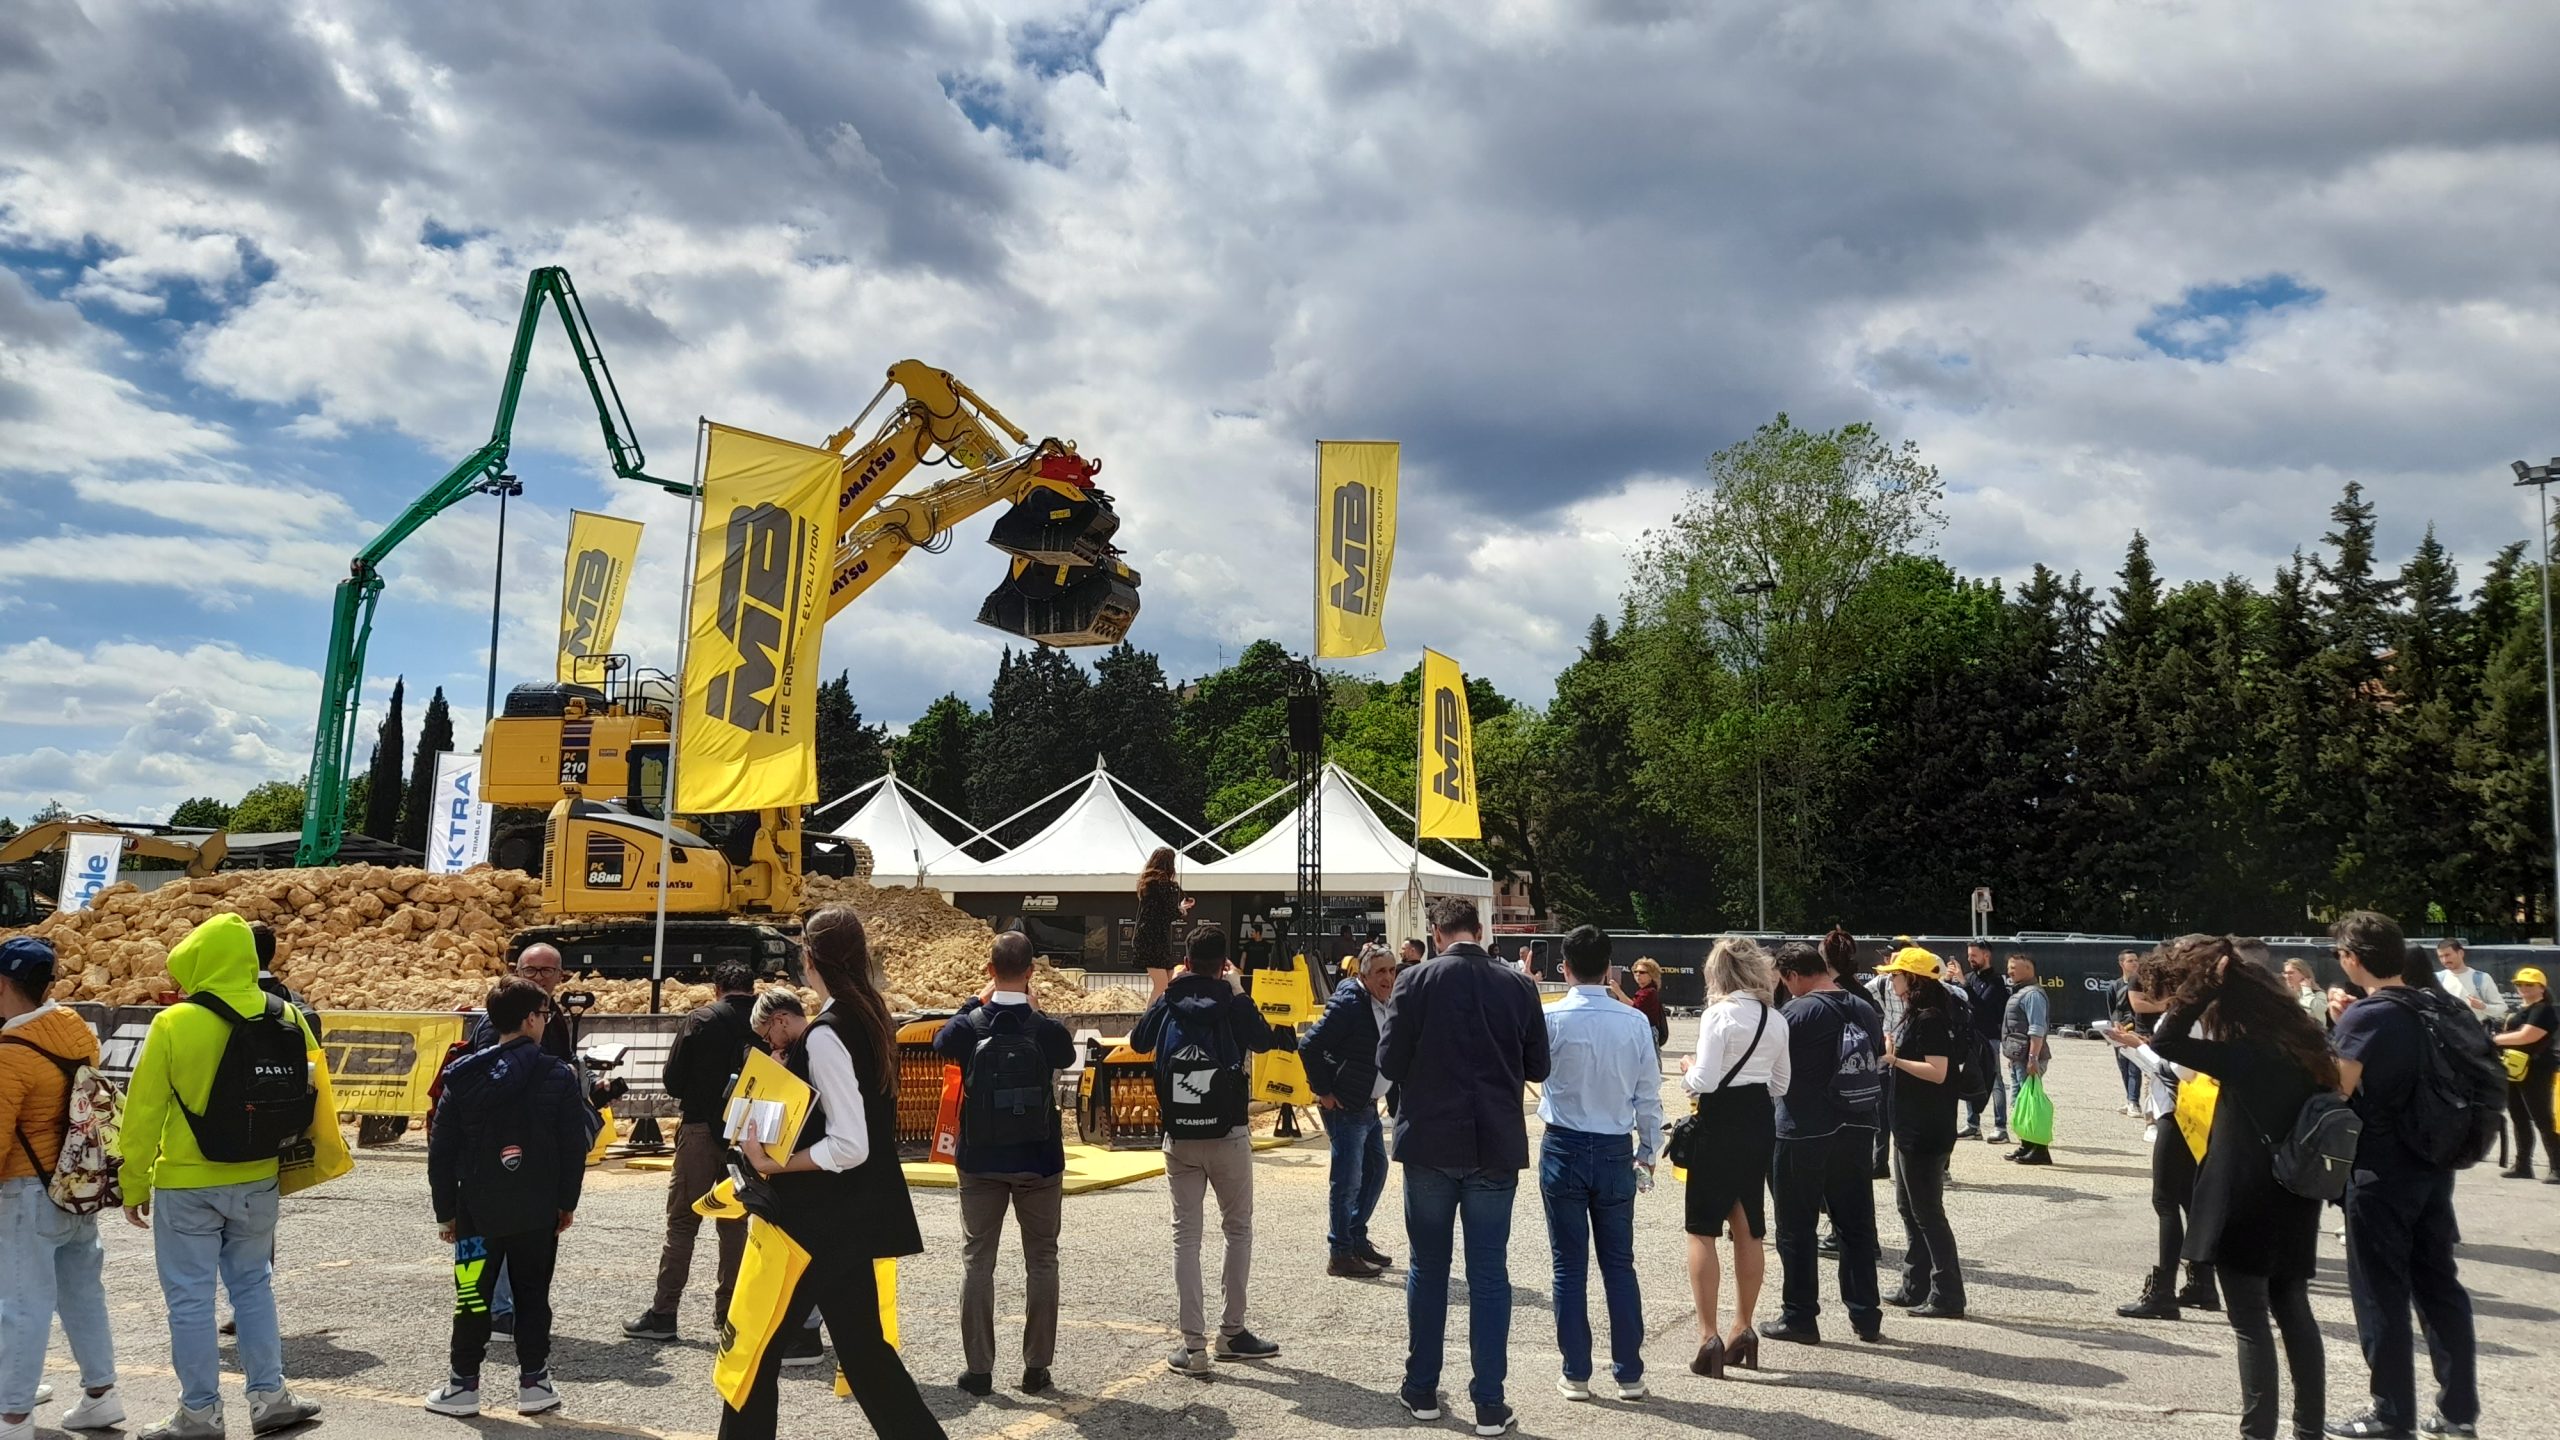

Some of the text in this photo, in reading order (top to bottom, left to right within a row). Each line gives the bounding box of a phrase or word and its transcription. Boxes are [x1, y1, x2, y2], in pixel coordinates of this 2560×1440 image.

[838, 447, 896, 513] OMATSU
[1376, 488, 1384, 546] EVOLUTION
[1331, 480, 1367, 615] MB
[610, 560, 624, 607] EVOLUTION
[829, 559, 869, 596] ATSU
[561, 549, 609, 661] MB
[705, 502, 792, 732] MB
[780, 523, 819, 736] THE EVOLUTION
[563, 752, 576, 761] PC
[1433, 686, 1460, 802] MB
[309, 728, 326, 811] SERMAC
[561, 762, 587, 773] 210
[445, 771, 473, 873] KTRA
[471, 819, 481, 857] TRIMBLE
[75, 855, 108, 909] ble
[588, 871, 622, 883] 88MR
[590, 862, 604, 871] PC
[646, 879, 694, 889] KOATSU
[1023, 895, 1059, 906] MB
[2038, 975, 2065, 988] Lab
[1260, 1002, 1291, 1013] MB
[255, 1065, 294, 1075] PARIS
[336, 1088, 405, 1099] EVOLUTION
[621, 1093, 673, 1101] OLUTIO
[941, 1123, 956, 1133] THE
